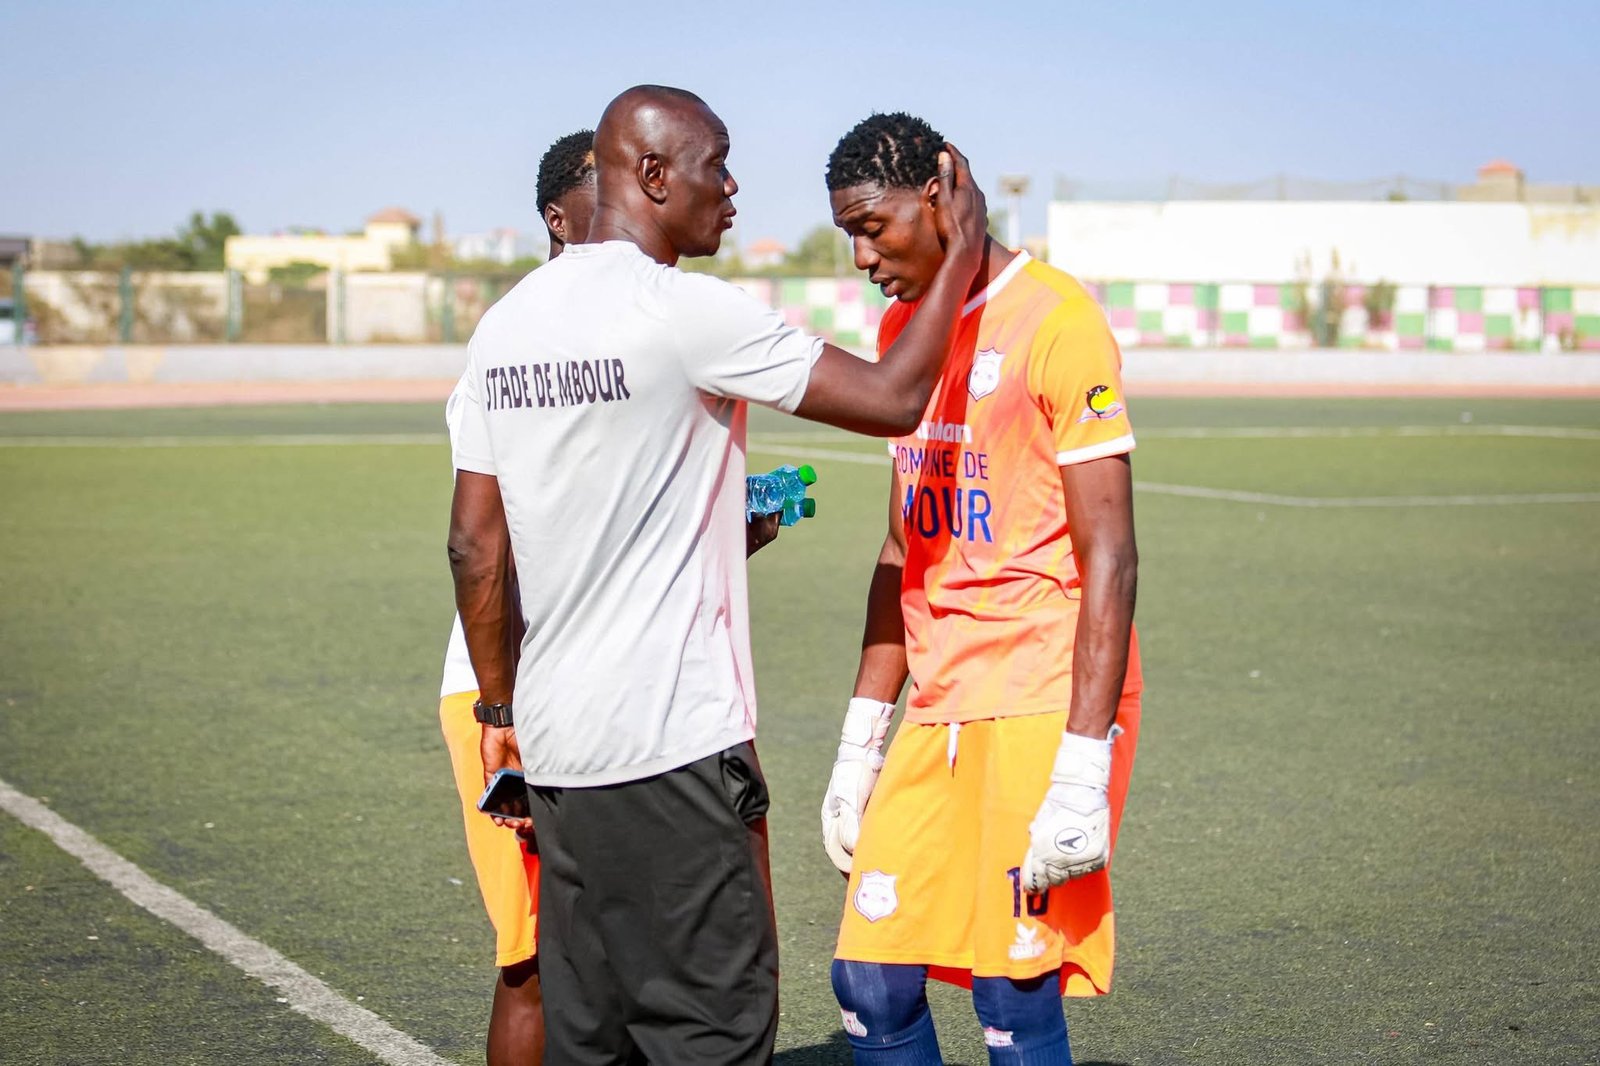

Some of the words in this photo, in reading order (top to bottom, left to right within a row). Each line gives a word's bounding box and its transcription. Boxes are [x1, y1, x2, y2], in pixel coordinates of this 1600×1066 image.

[485, 365, 532, 412] STADE
[532, 362, 556, 408] DE
[556, 358, 631, 407] MBOUR
[964, 451, 988, 480] DE
